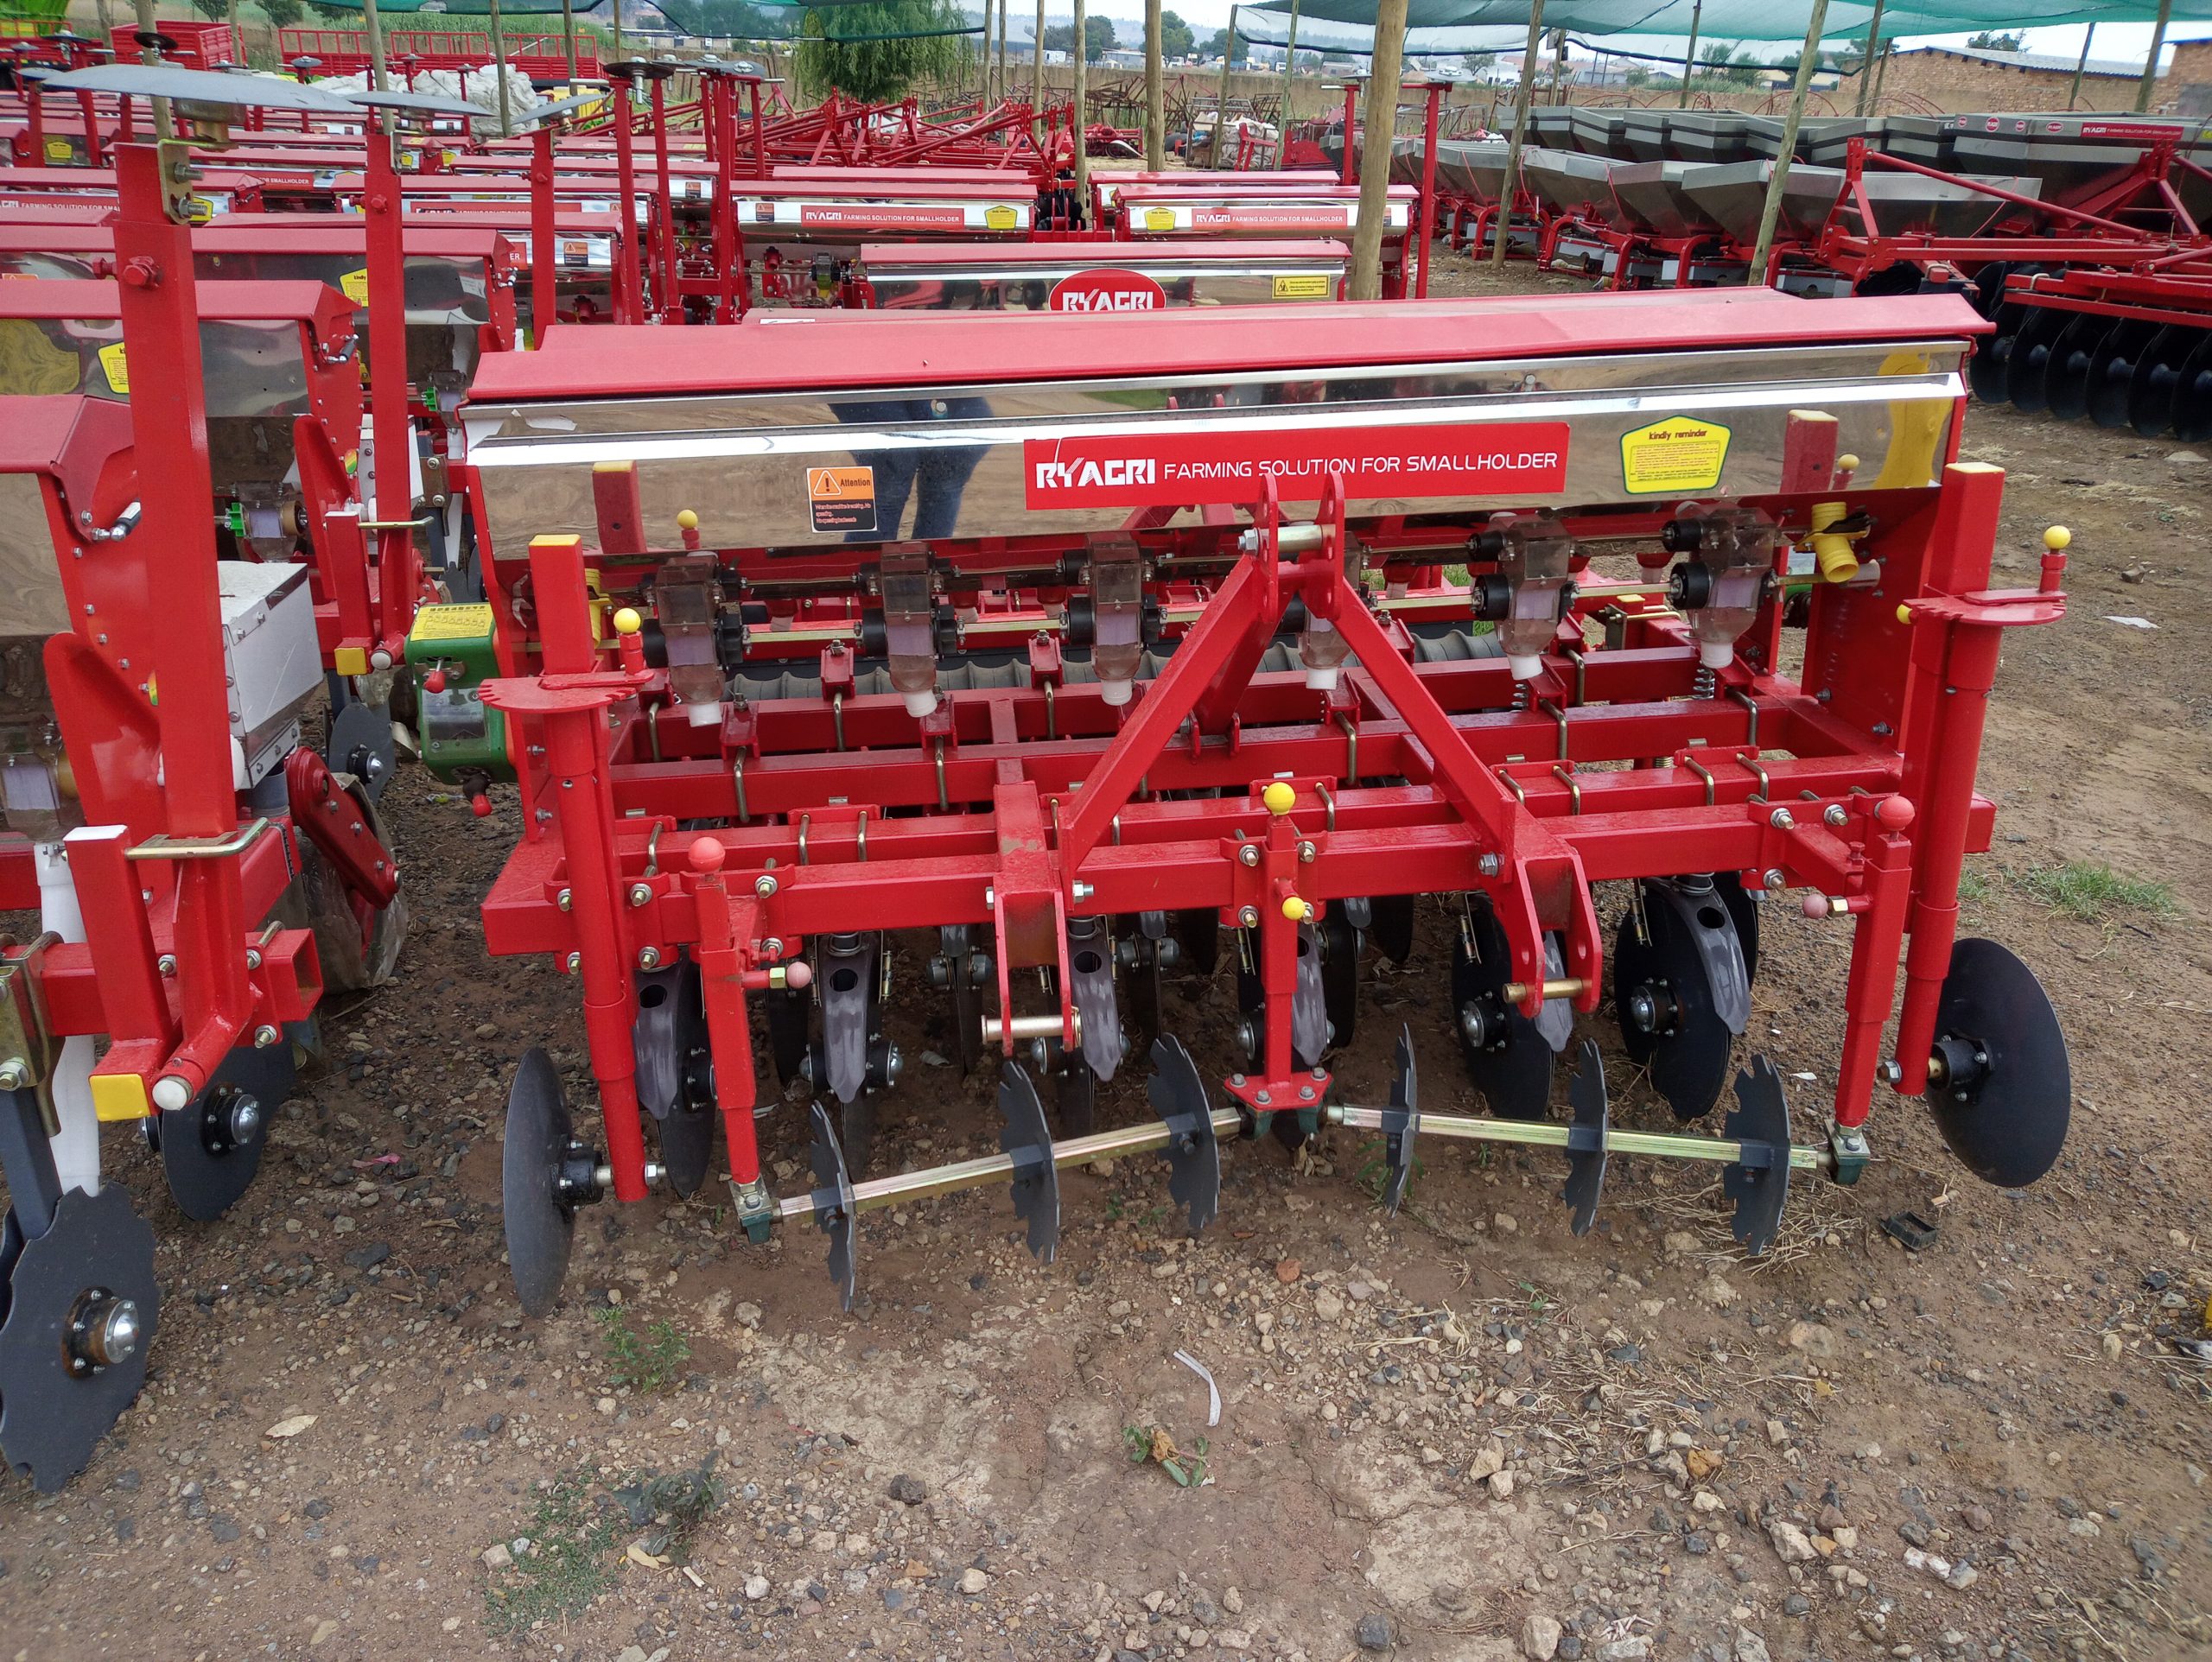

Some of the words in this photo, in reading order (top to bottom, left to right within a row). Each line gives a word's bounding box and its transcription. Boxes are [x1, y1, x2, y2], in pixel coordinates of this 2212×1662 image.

[805, 211, 842, 220] RYAGRI
[1196, 213, 1231, 223] RYAGRI
[1062, 288, 1154, 311] RYAGRI
[1649, 431, 1672, 441] kindly
[1675, 429, 1707, 439] reminder
[1036, 457, 1156, 489] RYAGRI
[1164, 460, 1252, 480] FARMING
[1257, 458, 1356, 477] SOLUTION
[1361, 456, 1401, 473] FOR
[1407, 452, 1558, 472] SMALLHOLDER
[840, 479, 871, 487] Attention
